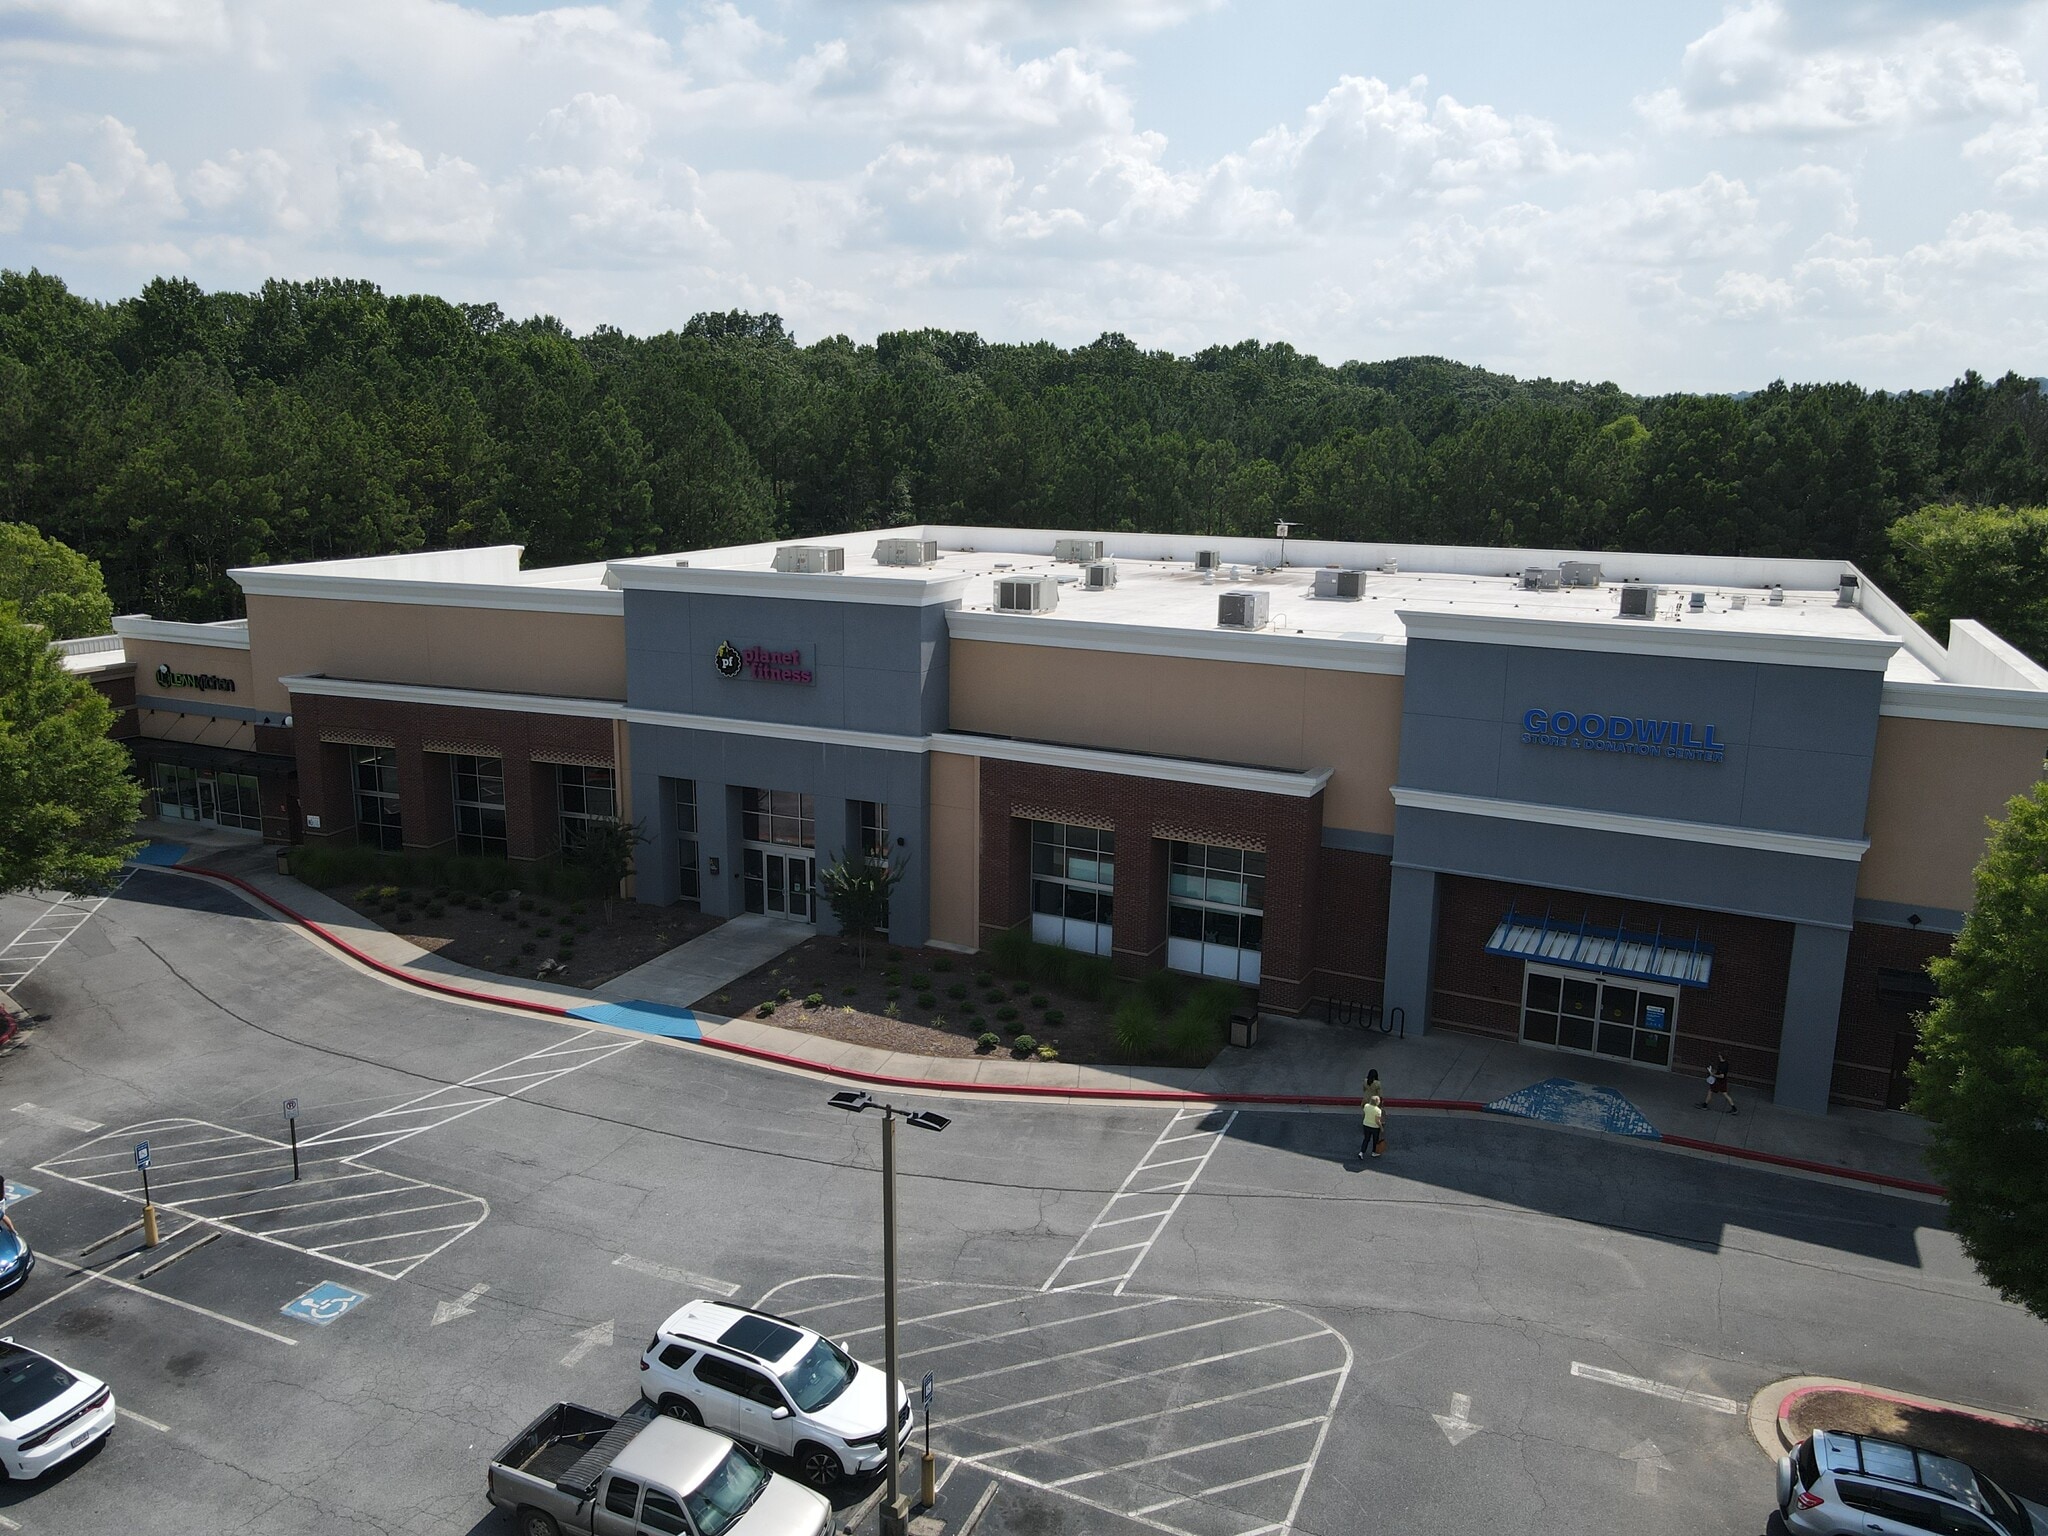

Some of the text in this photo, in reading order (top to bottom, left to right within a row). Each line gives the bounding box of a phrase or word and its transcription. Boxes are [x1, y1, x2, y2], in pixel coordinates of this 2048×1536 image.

[722, 656, 734, 668] pf
[742, 646, 800, 666] planet
[751, 662, 812, 683] fitness
[1522, 708, 1725, 751] GOODWILL
[1521, 732, 1725, 764] STORE & DONATION CENTER
